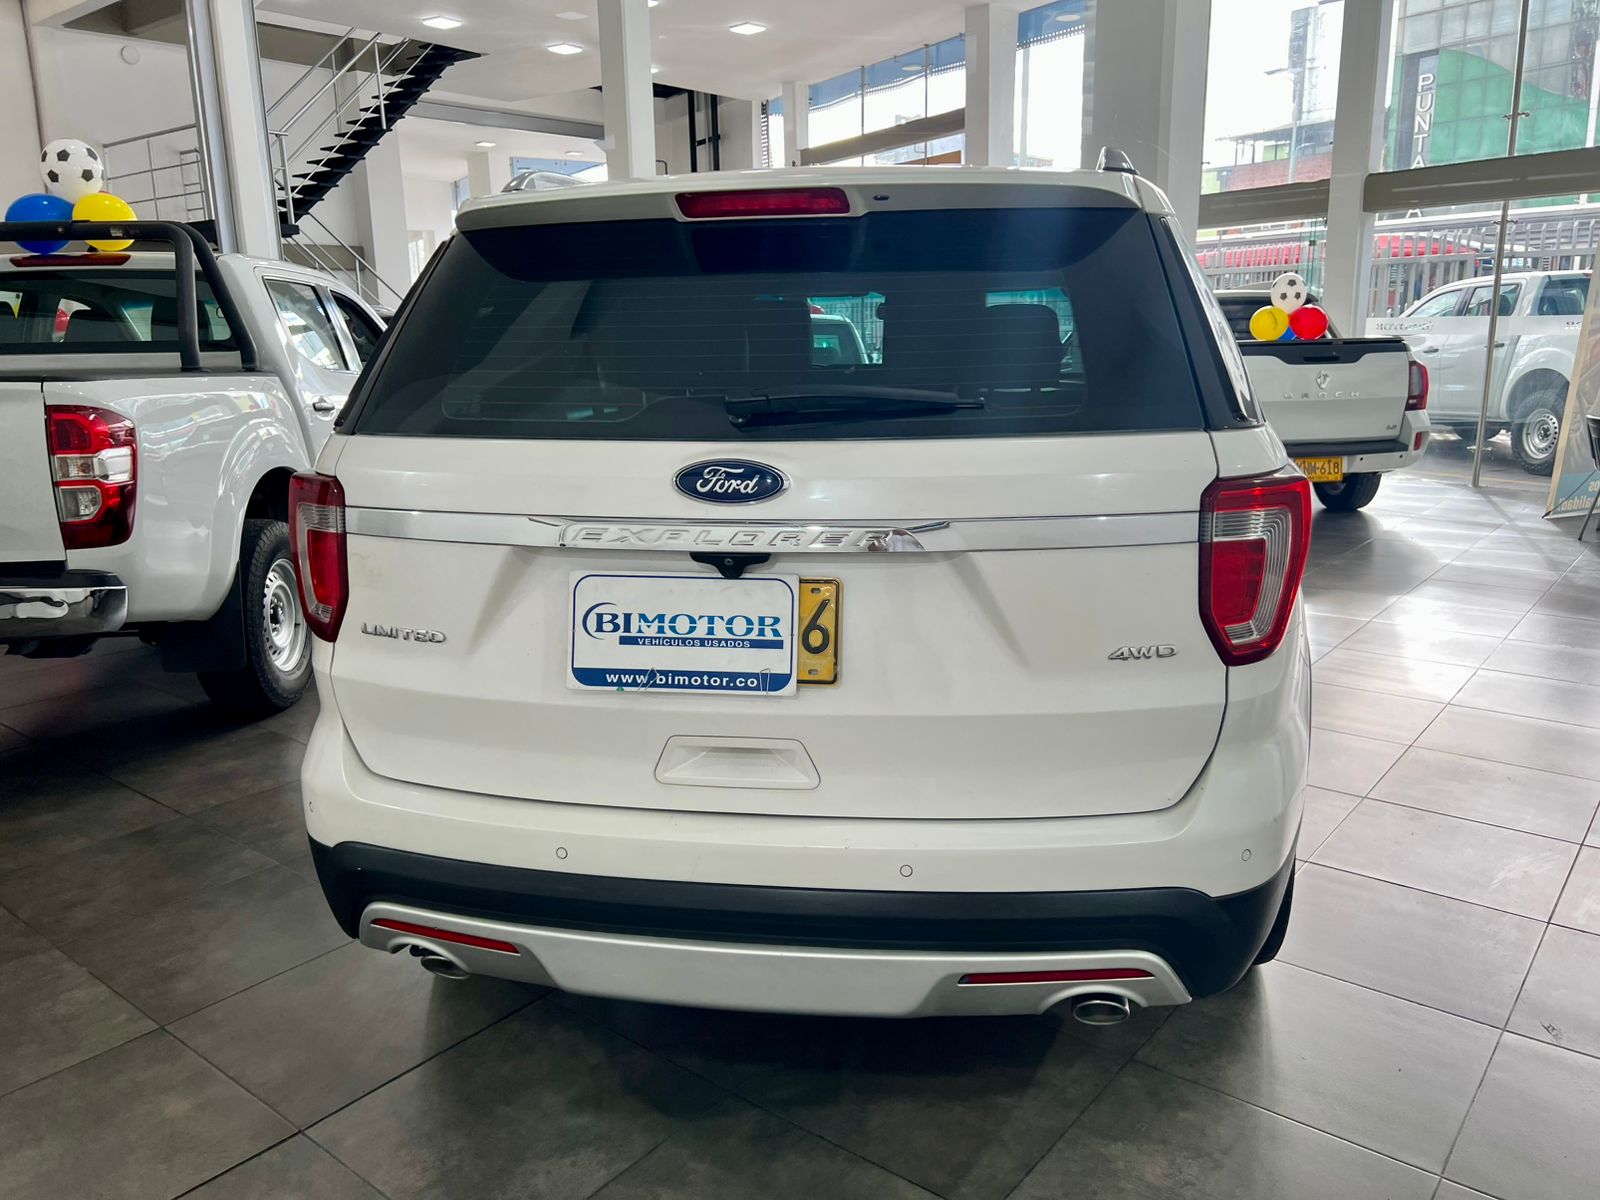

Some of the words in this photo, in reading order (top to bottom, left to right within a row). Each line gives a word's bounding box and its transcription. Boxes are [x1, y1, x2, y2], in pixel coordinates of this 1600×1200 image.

[696, 466, 759, 494] Ford
[571, 527, 895, 548] EXPLORER
[360, 622, 448, 643] LIMITED
[594, 612, 783, 638] BIMOTOR
[637, 636, 700, 648] VEHÍCULOS
[704, 640, 750, 648] USADOS
[1107, 643, 1177, 661] 4WD
[605, 671, 758, 688] www.bimotor.co
